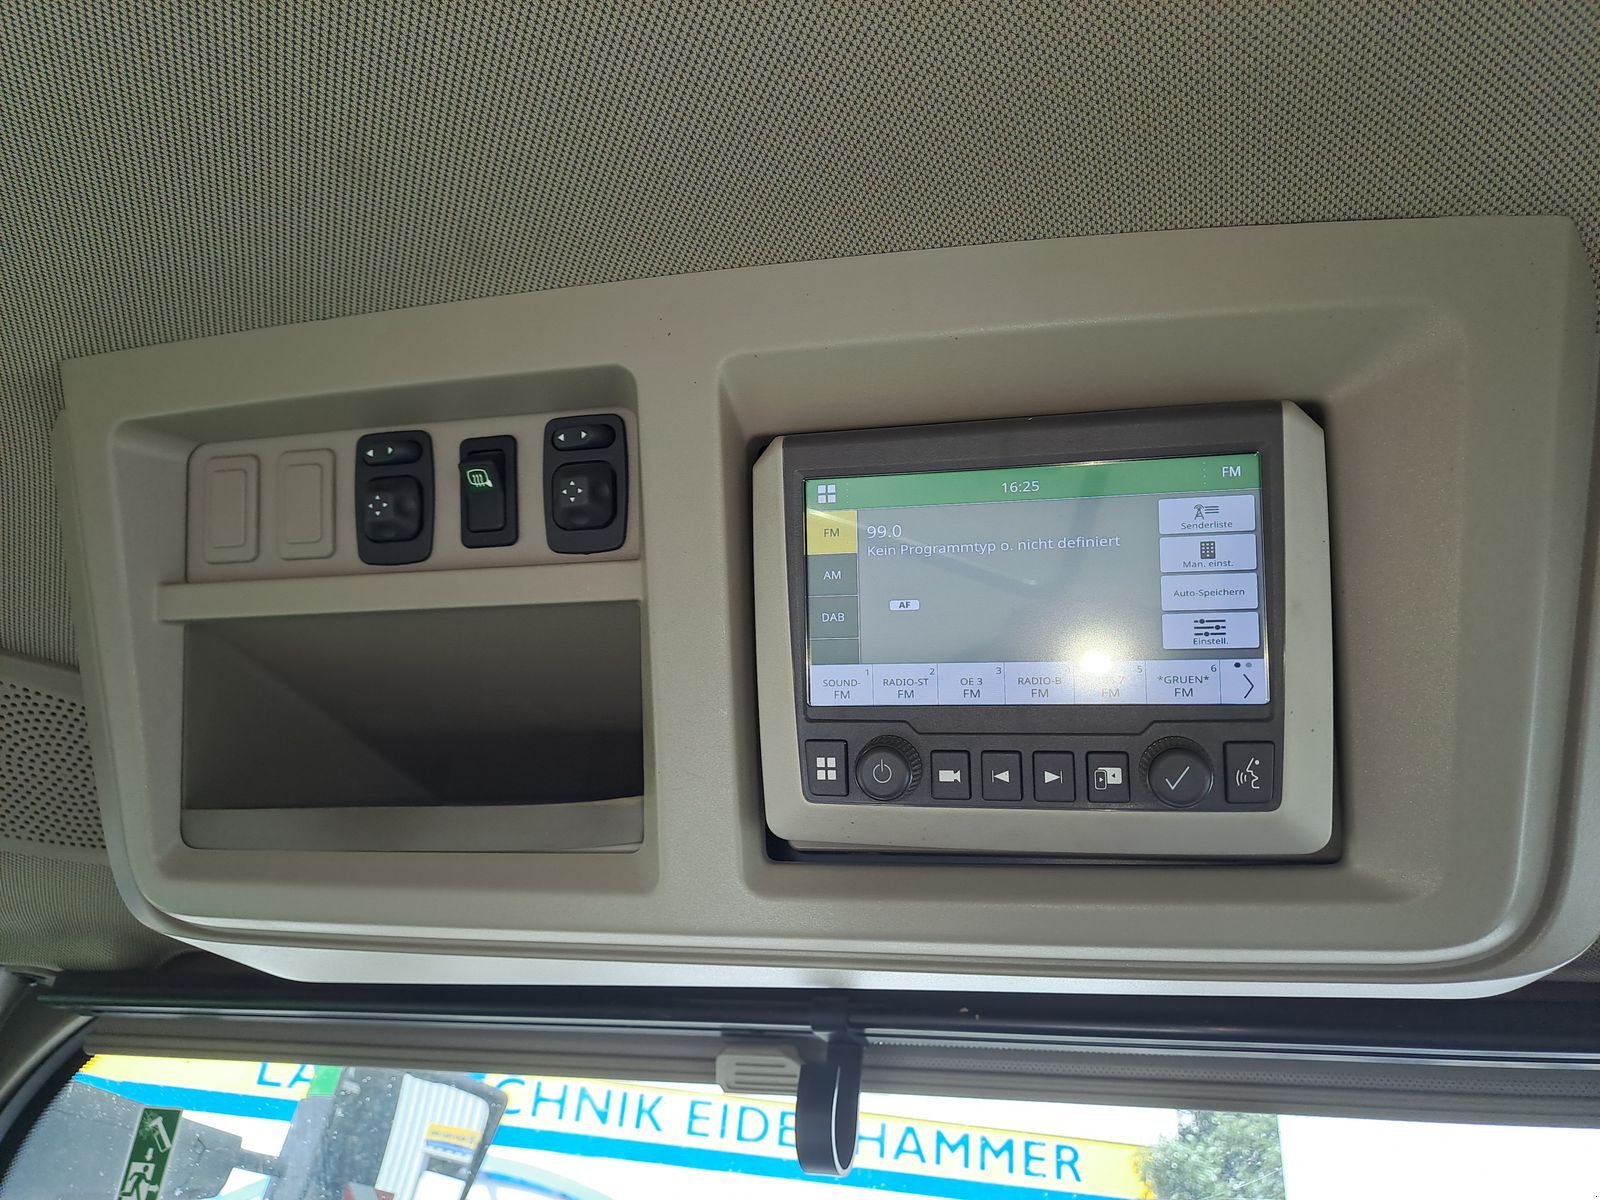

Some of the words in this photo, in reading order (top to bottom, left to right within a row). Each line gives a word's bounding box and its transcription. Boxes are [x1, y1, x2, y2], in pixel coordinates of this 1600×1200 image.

[1222, 466, 1241, 477] FM
[1001, 480, 1040, 493] 16:25
[1181, 520, 1233, 529] Senderliste
[823, 528, 840, 537] FM
[867, 524, 902, 538] 99.0
[867, 545, 896, 556] Kein
[900, 542, 996, 557] Programmtyp
[1000, 542, 1014, 551] o.
[1018, 538, 1054, 550] nicht
[1057, 536, 1120, 549] definiert
[1182, 560, 1206, 568] Man.
[1209, 559, 1234, 567] einst.
[823, 571, 841, 580] AM
[1173, 587, 1245, 598] Auto-Speichern
[822, 612, 845, 622] DAB
[1193, 637, 1229, 645] Einstell.
[930, 668, 935, 676] 2
[996, 667, 1002, 675] 3
[1136, 665, 1143, 674] 5
[1211, 664, 1217, 672] 6
[822, 679, 861, 687] SOUND-
[883, 678, 929, 686] RADIO-ST
[960, 677, 975, 686] OE
[977, 677, 983, 686] 3
[1017, 676, 1062, 685] RADIO-B
[834, 691, 850, 699] FM
[898, 690, 914, 699] FM
[963, 689, 981, 698] FM
[1031, 688, 1049, 698] FM
[1101, 688, 1120, 697] FM
[1174, 687, 1193, 697] FM
